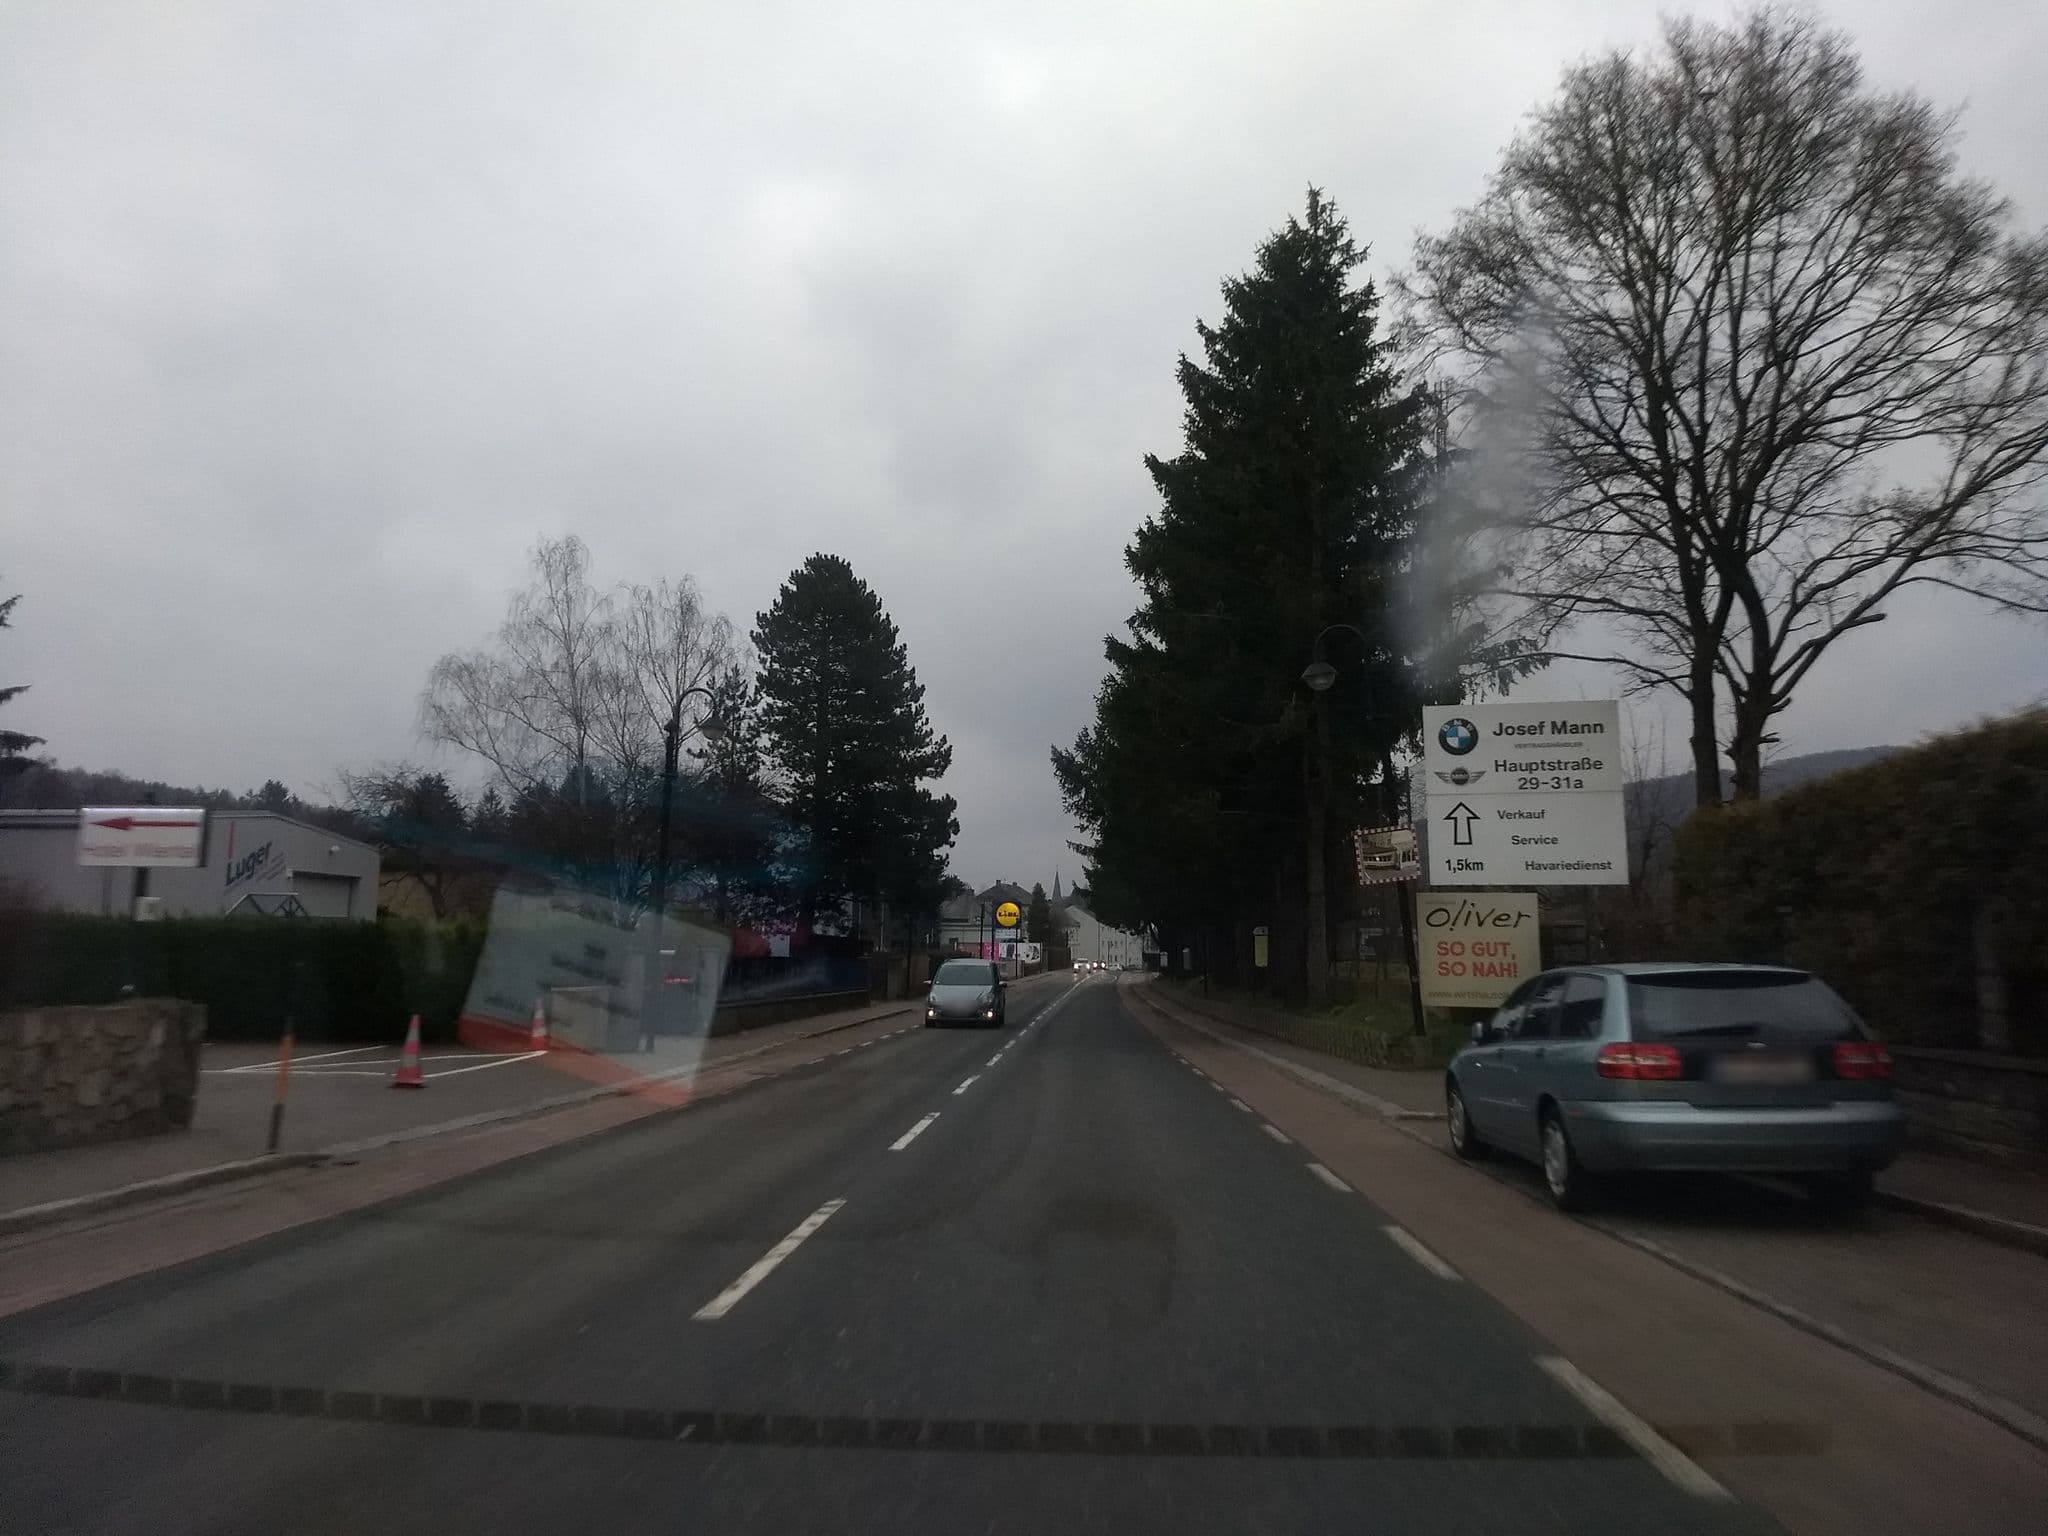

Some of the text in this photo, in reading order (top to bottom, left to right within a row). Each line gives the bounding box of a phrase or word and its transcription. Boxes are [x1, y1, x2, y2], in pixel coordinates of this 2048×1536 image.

[1493, 720, 1604, 737] Josef Mann
[1494, 757, 1604, 773] Hauptstraße
[1518, 776, 1584, 790] 29-31a
[1497, 809, 1546, 820] Verkauf
[1511, 834, 1559, 846] Service
[225, 841, 272, 886] Luger
[1445, 858, 1484, 874] 1,5km
[1524, 860, 1612, 872] Havariedienst
[1437, 942, 1517, 960] SO GUT,
[1438, 962, 1518, 978] SO NAH!
